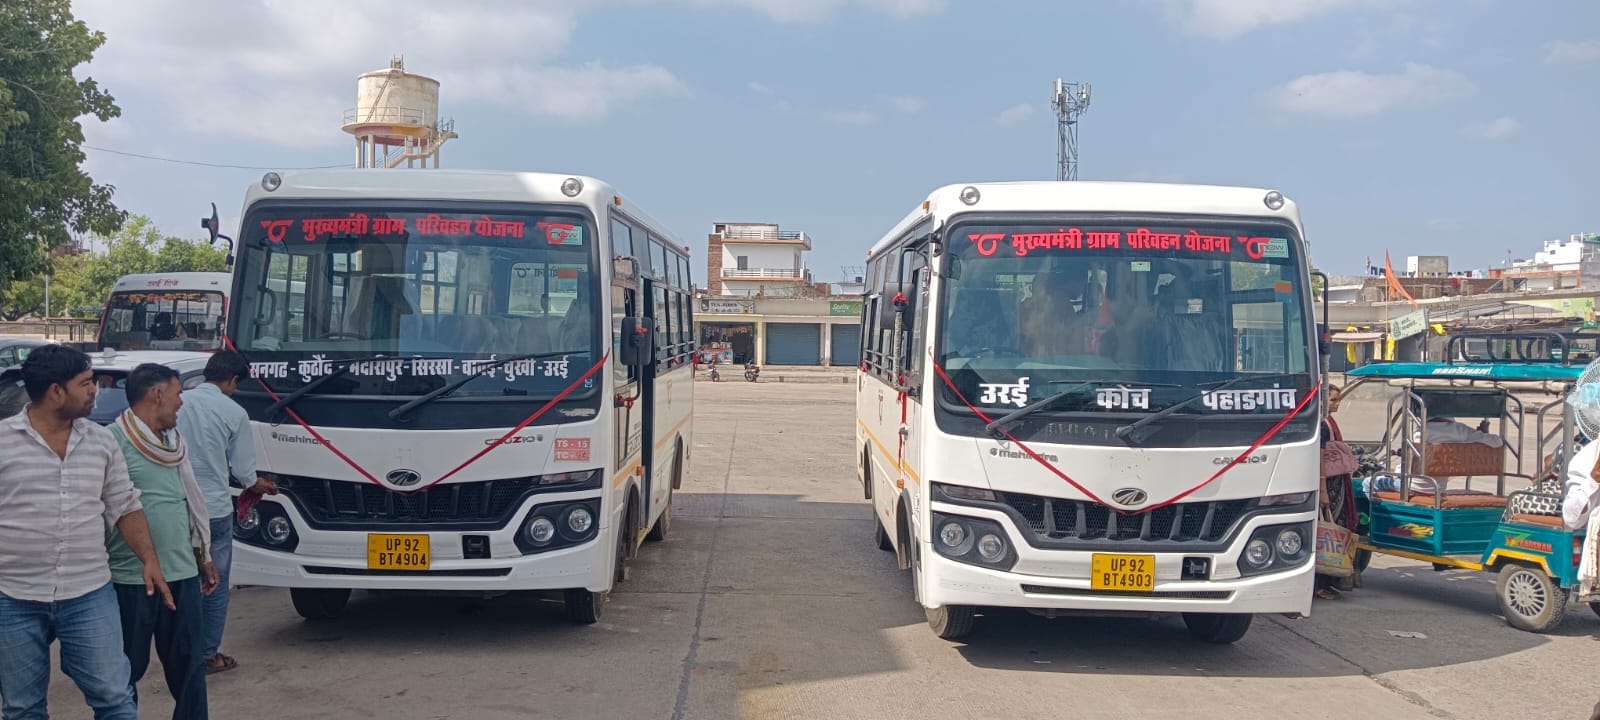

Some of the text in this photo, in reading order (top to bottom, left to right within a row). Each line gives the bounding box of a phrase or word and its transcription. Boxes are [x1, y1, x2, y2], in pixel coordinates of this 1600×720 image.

[302, 213, 525, 241] मुख्यमंत्री ग्राम परिवहन योजना
[1012, 228, 1231, 256] मुख्यमंत्री ग्राम परिवहन योजना
[544, 355, 569, 379] उरई
[979, 377, 1030, 408] उरई
[556, 440, 569, 448] TS
[386, 538, 420, 551] UP 92
[379, 552, 426, 566] BT4904
[1111, 558, 1145, 572] UP 92
[1103, 573, 1152, 587] BT4903
